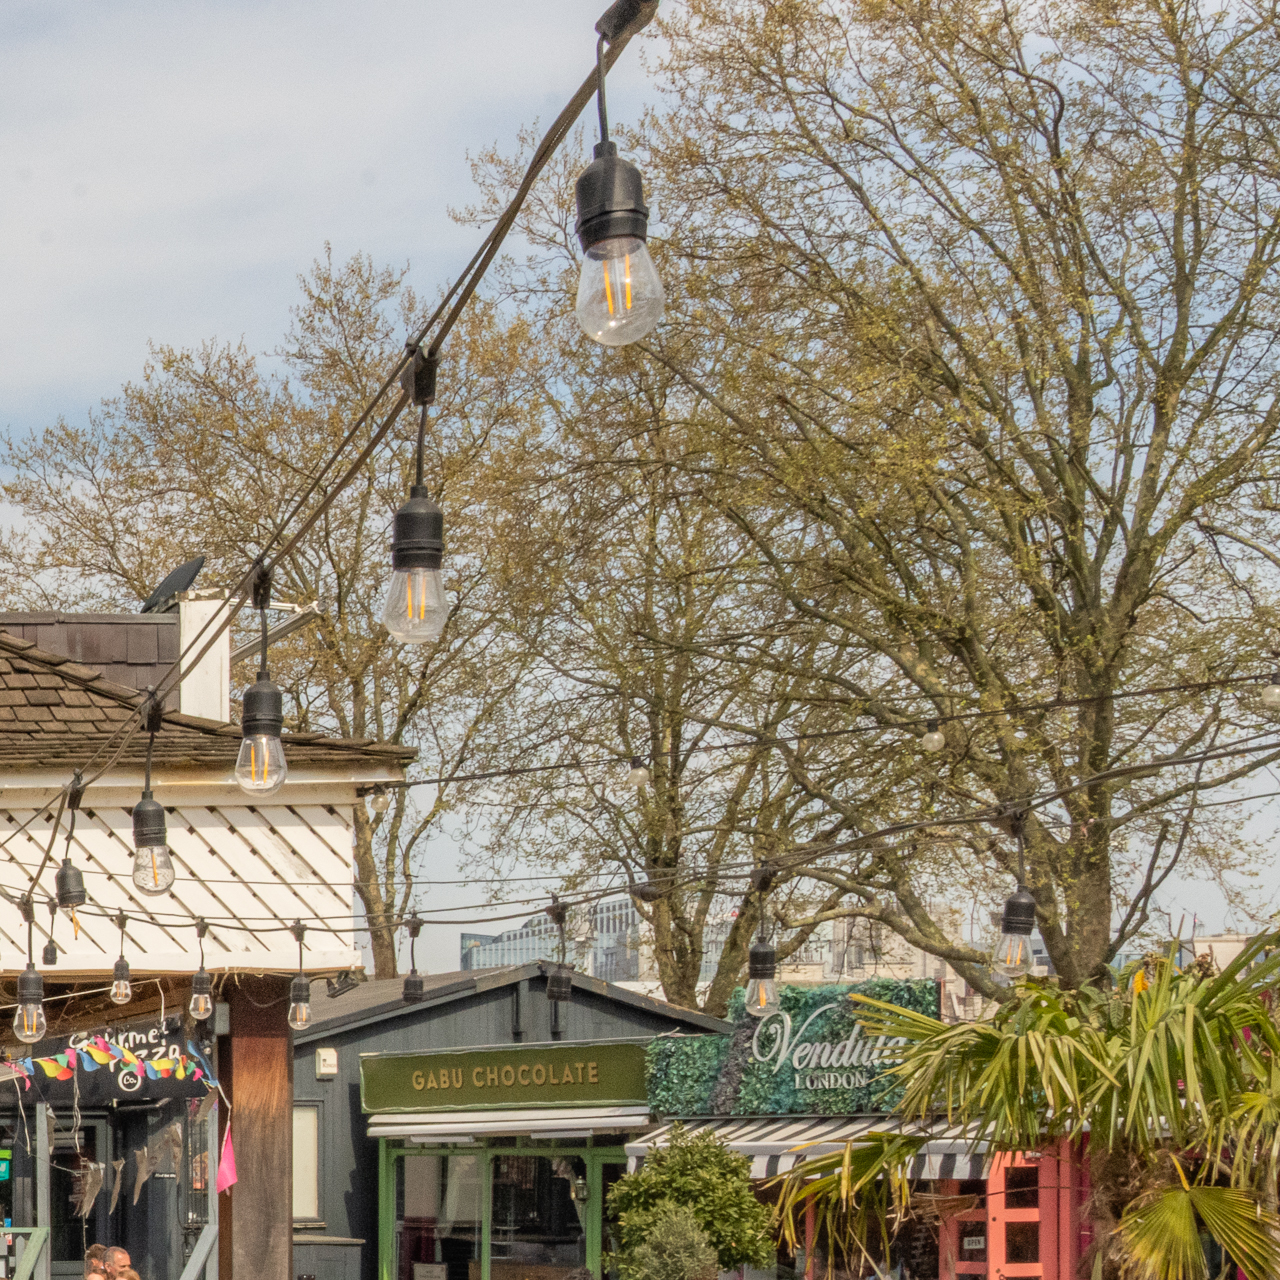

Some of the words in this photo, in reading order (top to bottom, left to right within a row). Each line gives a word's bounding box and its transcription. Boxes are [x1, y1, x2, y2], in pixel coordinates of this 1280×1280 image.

[412, 1068, 464, 1091] GABU
[472, 1062, 599, 1087] CHOCOLATE
[794, 1071, 867, 1089] LONDON
